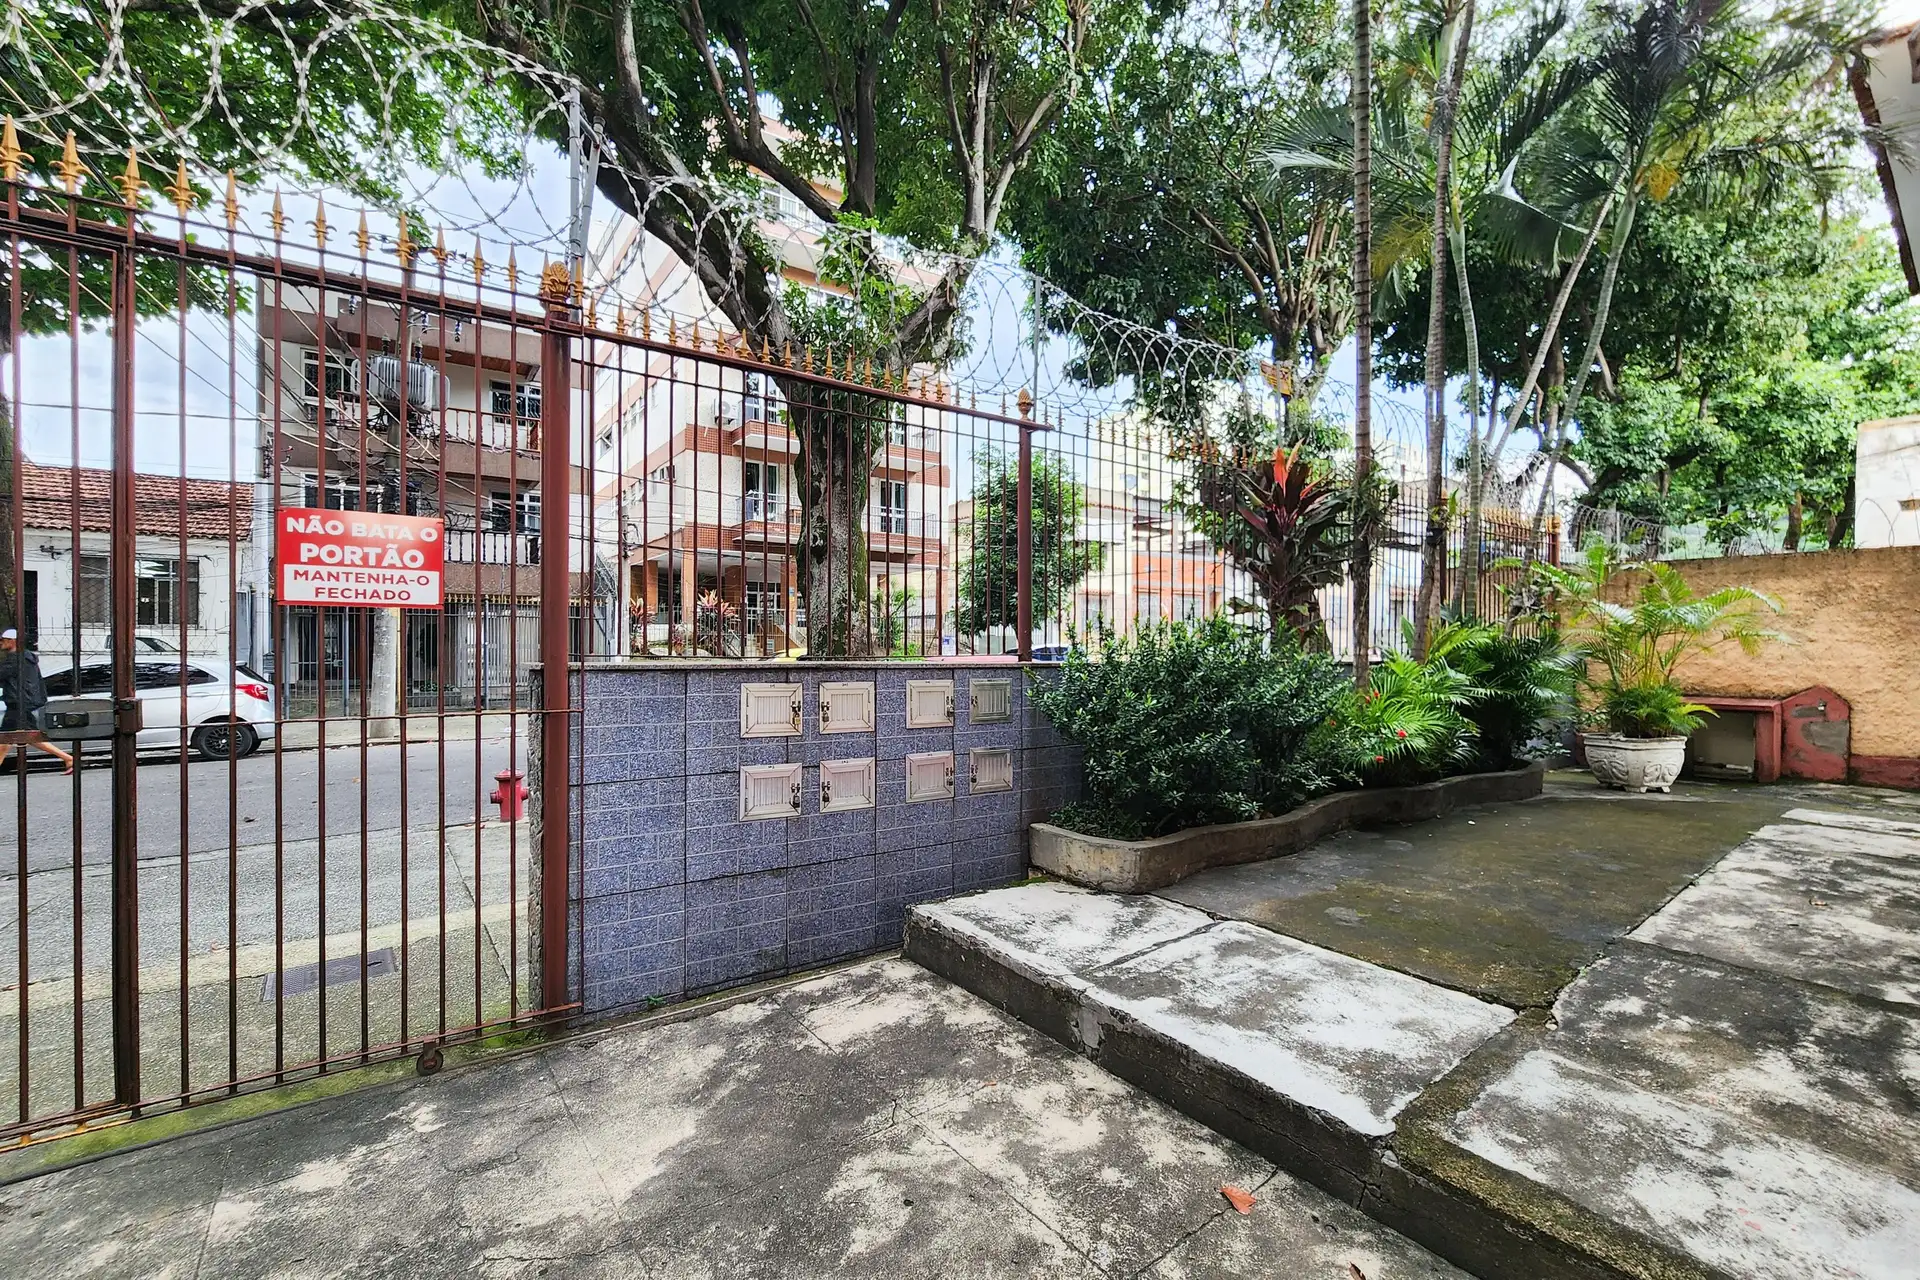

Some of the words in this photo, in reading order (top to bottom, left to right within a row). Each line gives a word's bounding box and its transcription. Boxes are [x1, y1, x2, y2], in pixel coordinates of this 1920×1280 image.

[286, 515, 345, 536] NÃO
[352, 522, 414, 541] BATA
[420, 527, 438, 542] O
[300, 543, 425, 568] PORTÃO
[293, 569, 430, 586] MANTENHA-O
[314, 587, 411, 601] FECHADO
